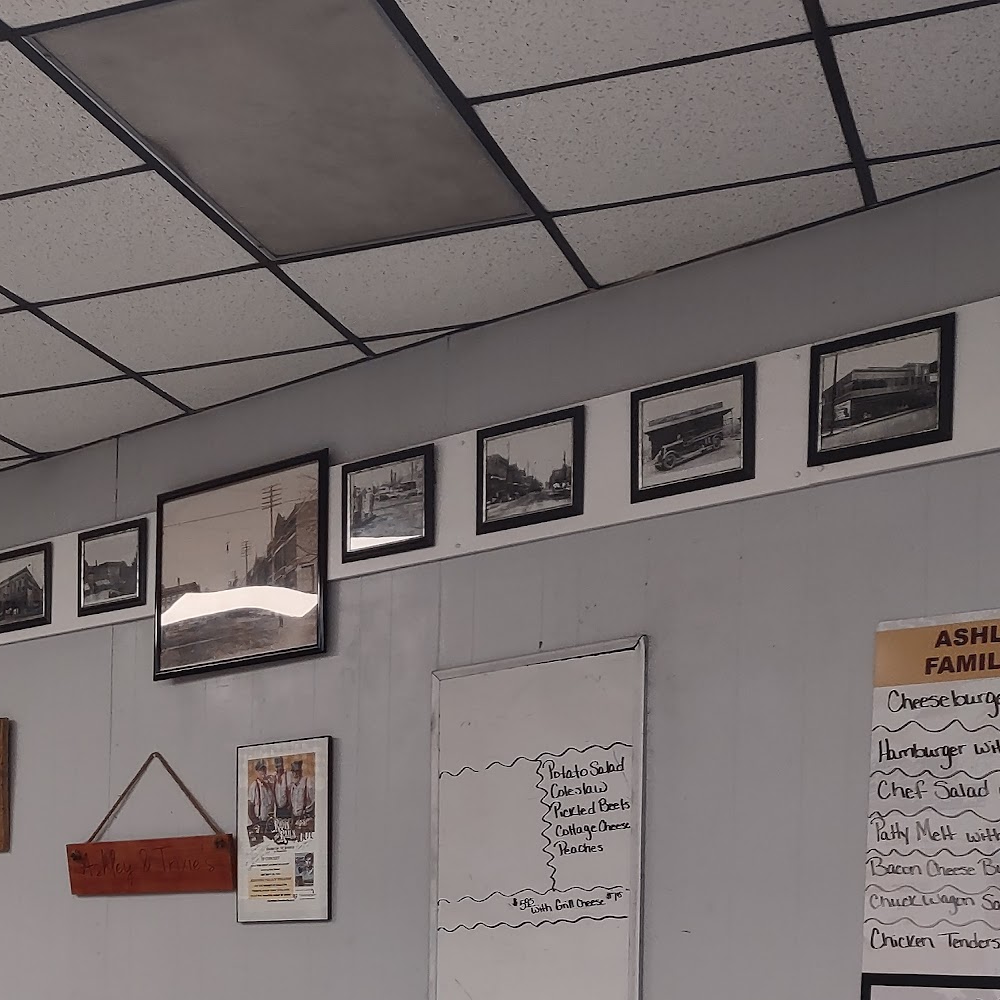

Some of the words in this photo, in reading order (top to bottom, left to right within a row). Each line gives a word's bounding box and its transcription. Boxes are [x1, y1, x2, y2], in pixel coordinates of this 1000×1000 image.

[935, 625, 1000, 648] ASHL
[925, 652, 1000, 675] FAMIL
[879, 738, 967, 770] Hamburger
[542, 760, 588, 779] Potato
[590, 756, 625, 776] Salad
[551, 781, 608, 798] Coleslaw
[878, 780, 928, 799] Chef
[934, 780, 990, 799] Salad
[551, 802, 596, 818] Pickled
[598, 798, 631, 812] Beets
[556, 823, 597, 841] Cottage
[599, 820, 631, 832] Cheese
[870, 817, 909, 845] Patty
[916, 818, 957, 841] Melt
[553, 840, 604, 856] Peaches
[865, 856, 922, 877] Bacon
[926, 859, 977, 877] Cheese
[555, 898, 574, 911] Grill
[576, 898, 606, 908] Cheese
[871, 928, 935, 949] Chicken
